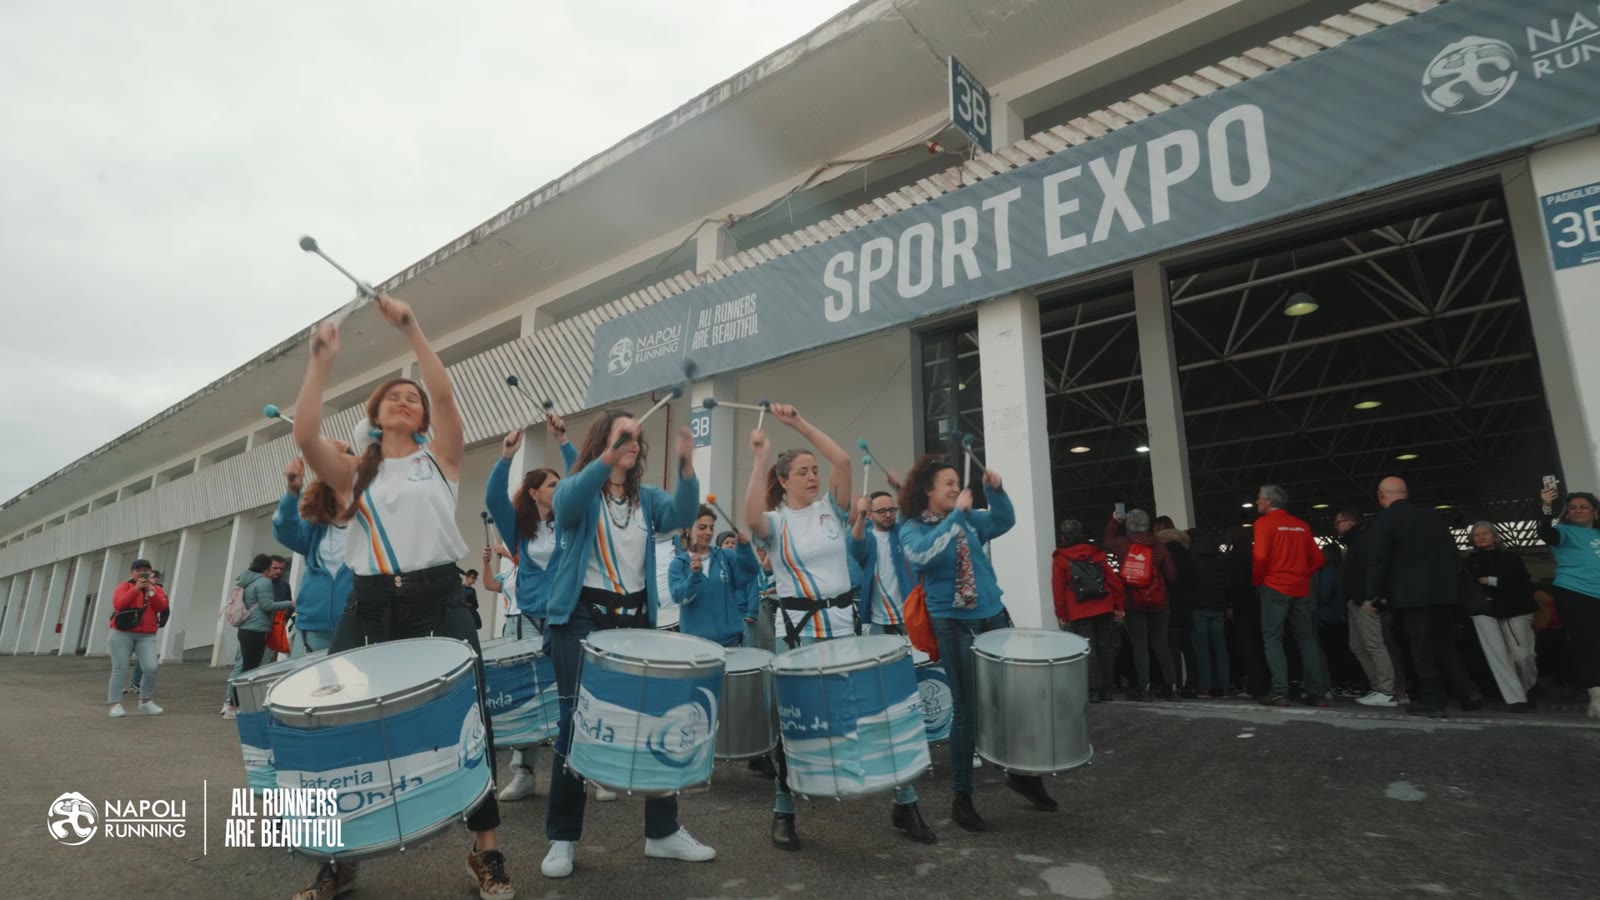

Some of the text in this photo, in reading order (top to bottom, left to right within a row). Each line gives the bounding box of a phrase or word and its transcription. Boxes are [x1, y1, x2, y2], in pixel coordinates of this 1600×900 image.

[1526, 4, 1600, 52] NA
[956, 75, 988, 136] 3B
[823, 103, 1271, 323] SPORT EXPO
[698, 293, 757, 329] ALL RUNNERS
[636, 323, 682, 348] NAPOLI
[692, 313, 759, 350] ARE BEAUTIFUL
[635, 342, 679, 364] RUNNING
[691, 416, 710, 438] 3B
